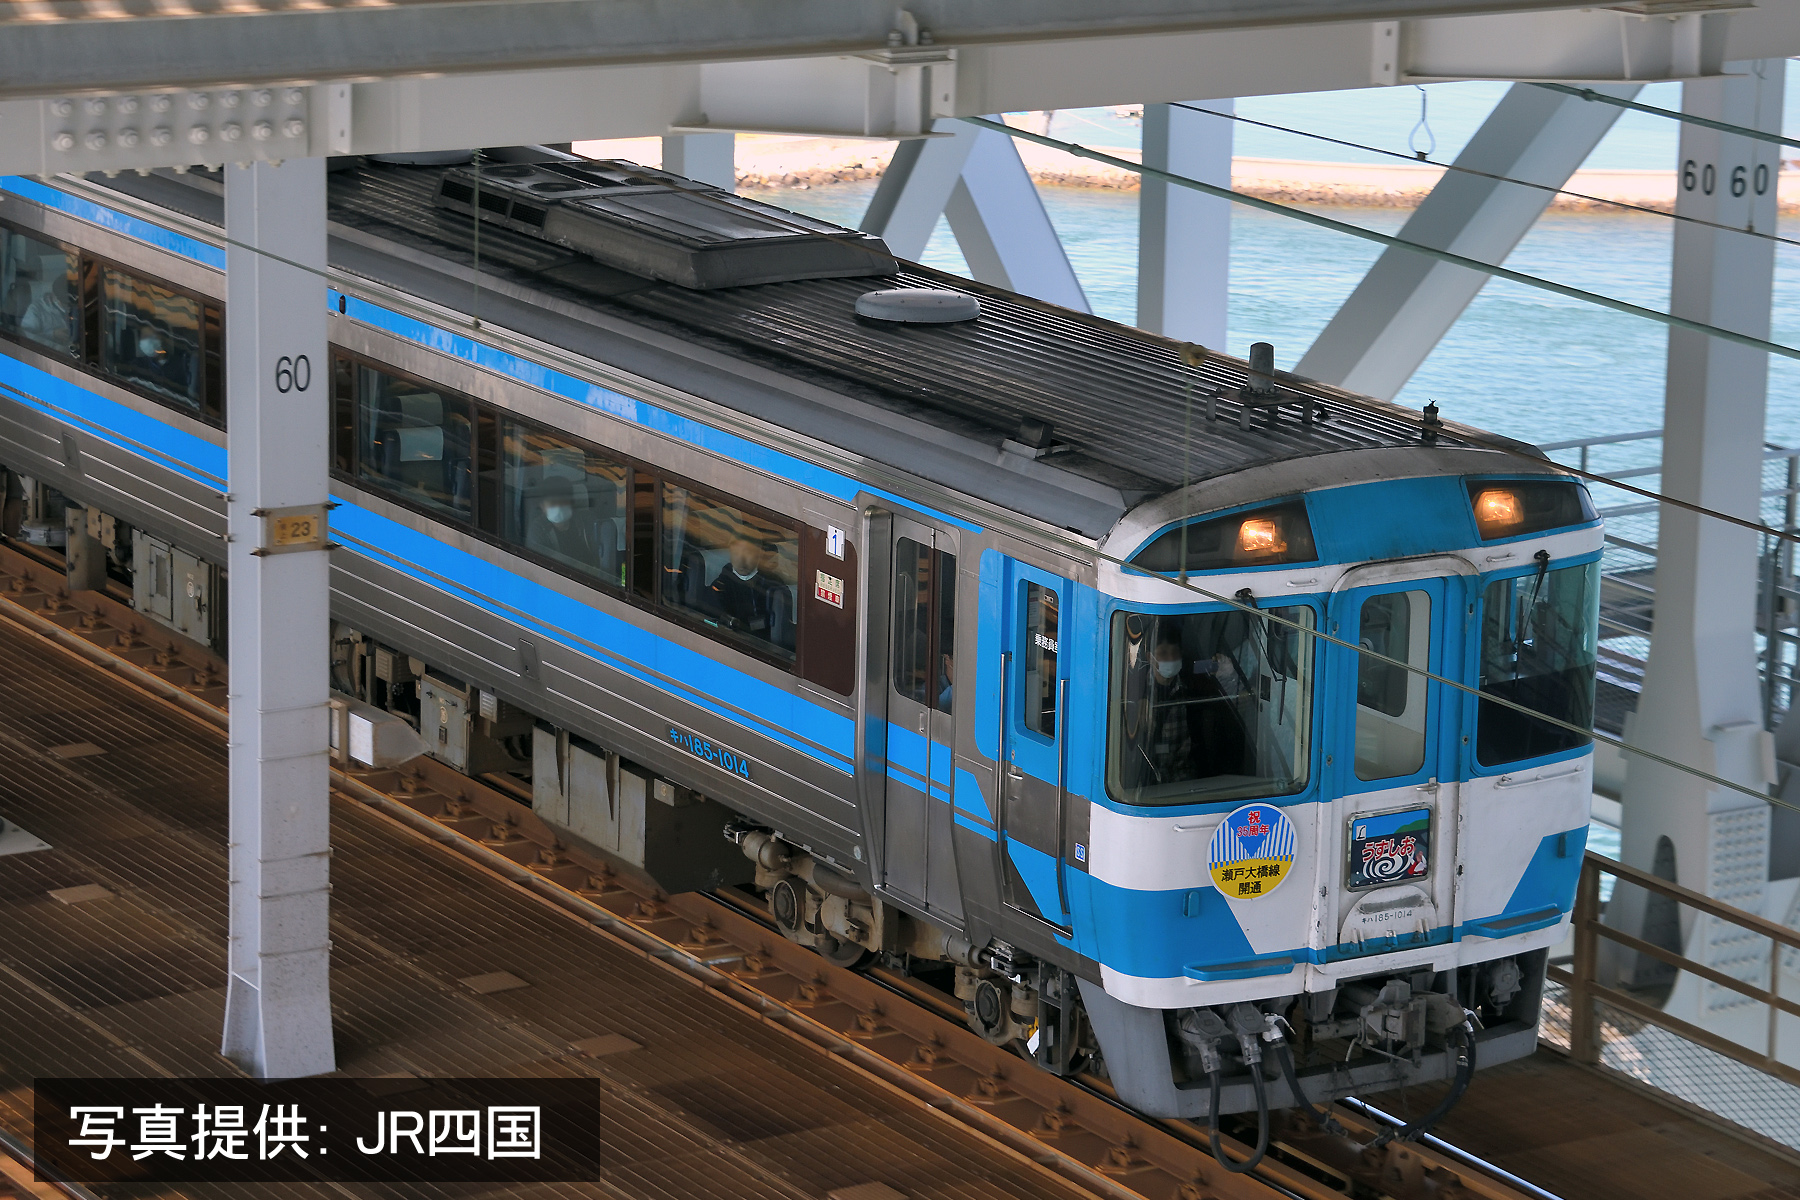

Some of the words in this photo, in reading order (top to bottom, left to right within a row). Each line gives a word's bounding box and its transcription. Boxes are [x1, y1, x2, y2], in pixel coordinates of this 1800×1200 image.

[1682, 159, 1716, 196] 60
[1730, 164, 1769, 198] 60
[275, 354, 311, 394] 60
[291, 521, 311, 538] 23
[669, 728, 749, 778] キハ185-1014
[1248, 811, 1260, 825] 祝
[1237, 824, 1270, 837] 35周年
[1362, 836, 1416, 863] うずしお
[1221, 864, 1281, 882] 瀬戸大橋線
[1238, 881, 1262, 895] 開通
[1361, 909, 1413, 924] キハ185-1014
